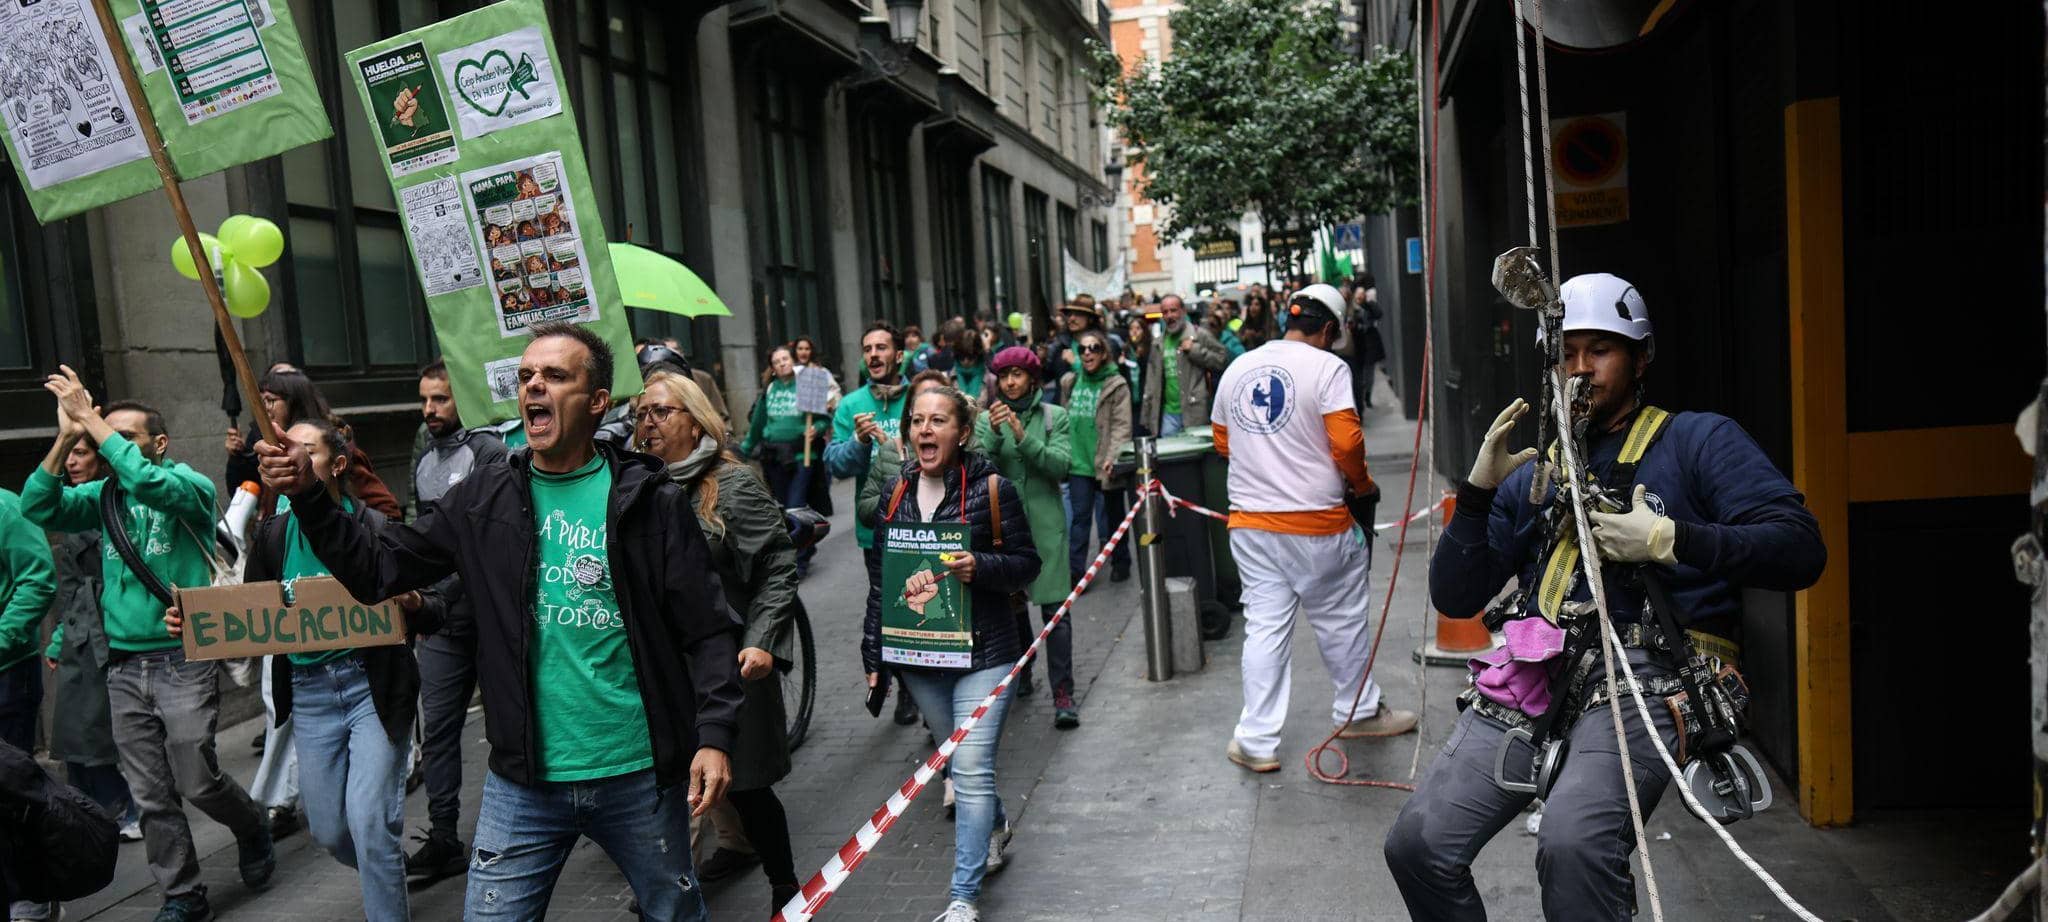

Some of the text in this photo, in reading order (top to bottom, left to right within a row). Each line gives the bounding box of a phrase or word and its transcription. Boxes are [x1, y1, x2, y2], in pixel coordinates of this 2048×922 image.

[364, 55, 406, 77] HUELGA
[368, 69, 396, 84] EDUCATIVA
[395, 60, 424, 74] INDEFINIDA
[472, 82, 507, 102] EN HUELGA
[559, 518, 607, 550] PÚBLI
[888, 528, 962, 542] HUELGA 14-O
[888, 541, 962, 550] EDUCATIVA INDEFINIDA
[190, 604, 392, 646] EDUCACION
[544, 604, 624, 630] TOD@S
